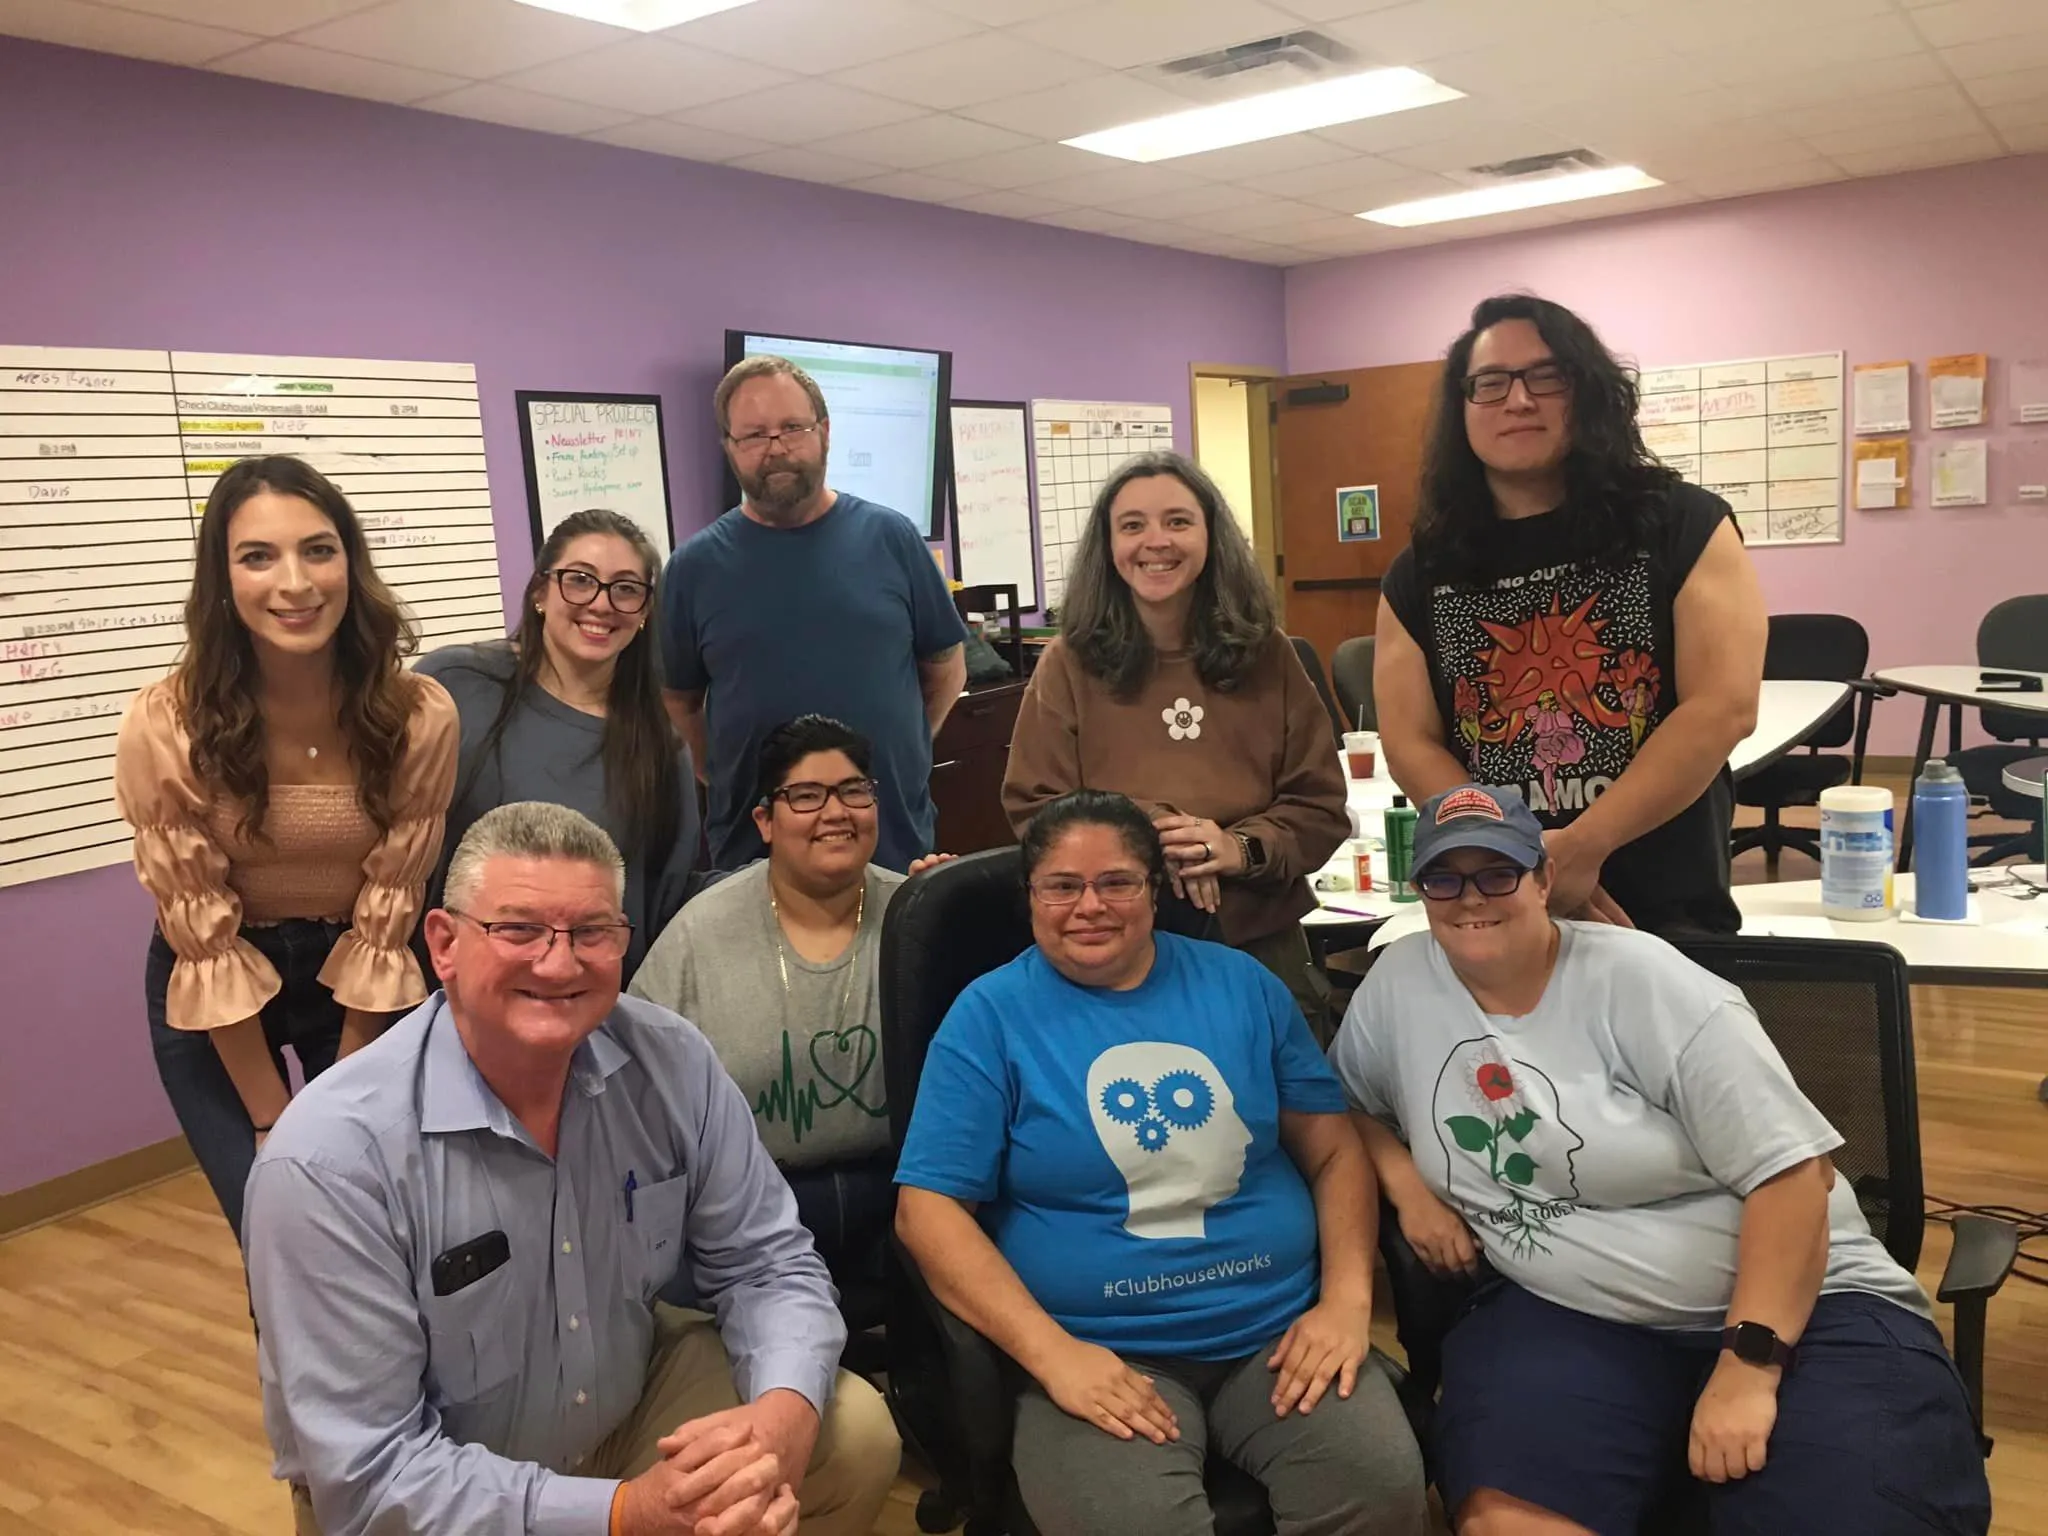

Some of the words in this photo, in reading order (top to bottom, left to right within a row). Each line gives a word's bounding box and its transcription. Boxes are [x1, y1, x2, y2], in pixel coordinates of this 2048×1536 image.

[178, 399, 206, 411] Check
[207, 400, 251, 413] Clubhouse
[534, 403, 592, 427] SPECIAL
[596, 404, 656, 424] PROJECTS
[184, 441, 203, 450] Post
[203, 441, 213, 450] to
[213, 441, 237, 450] Social
[238, 440, 262, 450] Media
[550, 431, 607, 448] Newsletter
[28, 485, 71, 499] Davis
[1103, 1251, 1273, 1299] #ClubhouseWorks
